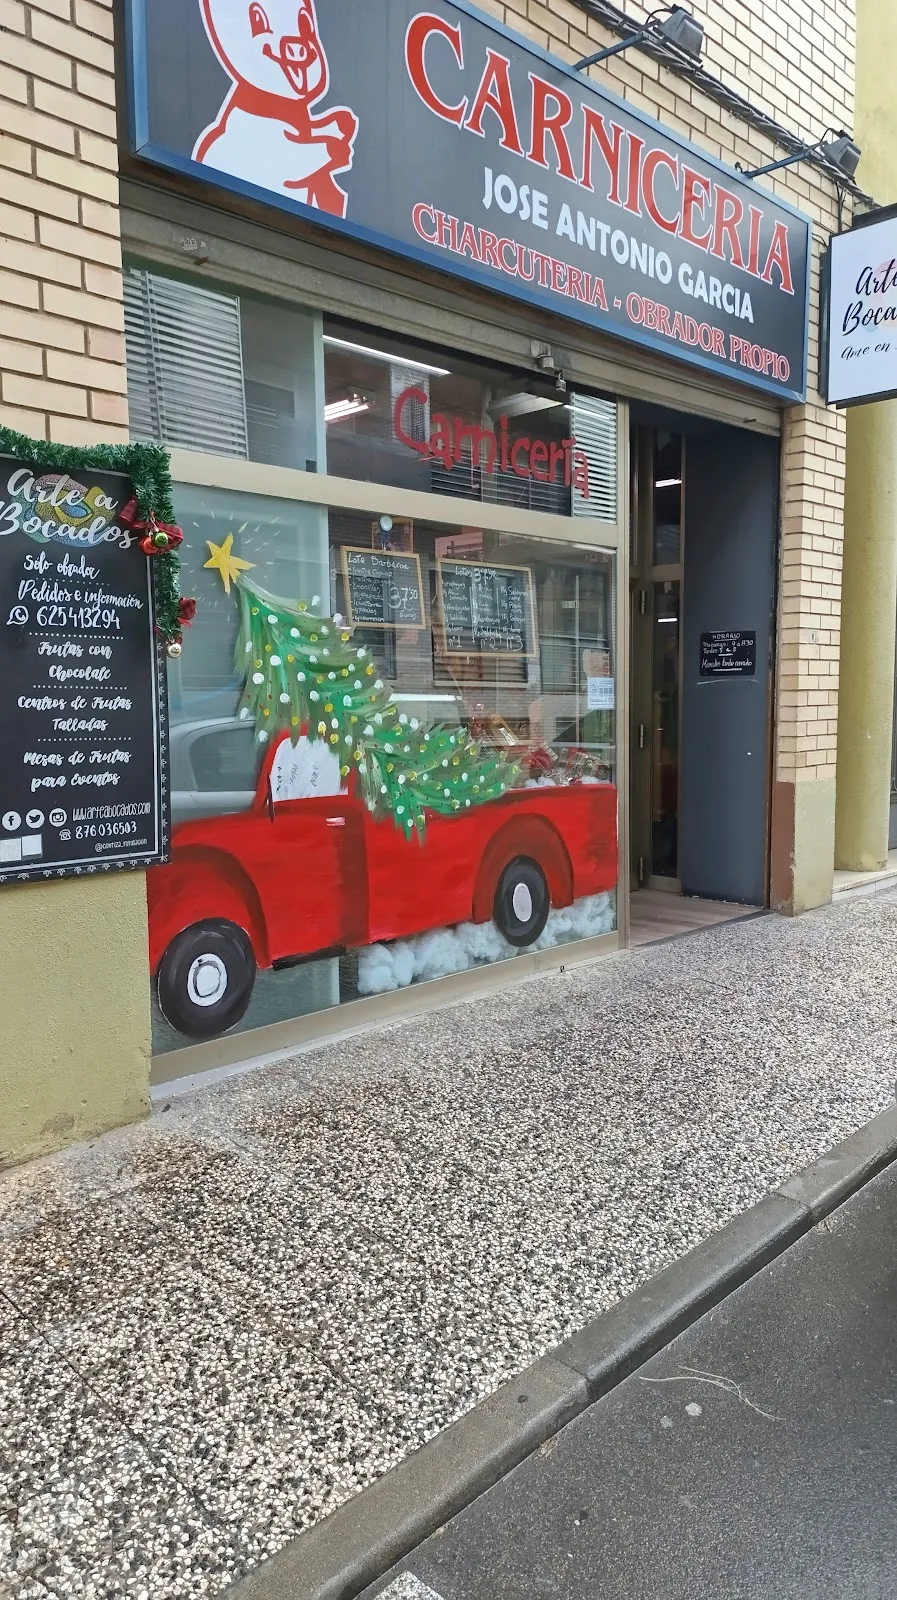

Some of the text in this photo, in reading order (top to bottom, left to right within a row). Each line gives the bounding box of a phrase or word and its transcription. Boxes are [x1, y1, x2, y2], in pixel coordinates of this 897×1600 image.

[404, 11, 795, 296] CARNICERIA
[482, 167, 754, 324] JOSE ANTONIO GARCIA
[411, 202, 609, 312] CHARCUTERIA
[625, 292, 726, 358] OBRADOR
[729, 337, 791, 383] PROPIO
[874, 342, 890, 353] en
[6, 468, 120, 510] Arte a
[0, 502, 139, 549] Bocados
[57, 552, 100, 579] obrador
[18, 580, 72, 603] Pedidos
[74, 589, 82, 602] e
[712, 632, 741, 640] HORARIO
[38, 641, 113, 659] Frutas con
[48, 665, 112, 682] Chocolate
[17, 695, 133, 711] Centros de Frutas
[52, 717, 109, 732] Talladas
[23, 749, 132, 767] Mesas de Frutas
[30, 771, 121, 793] para Eventos
